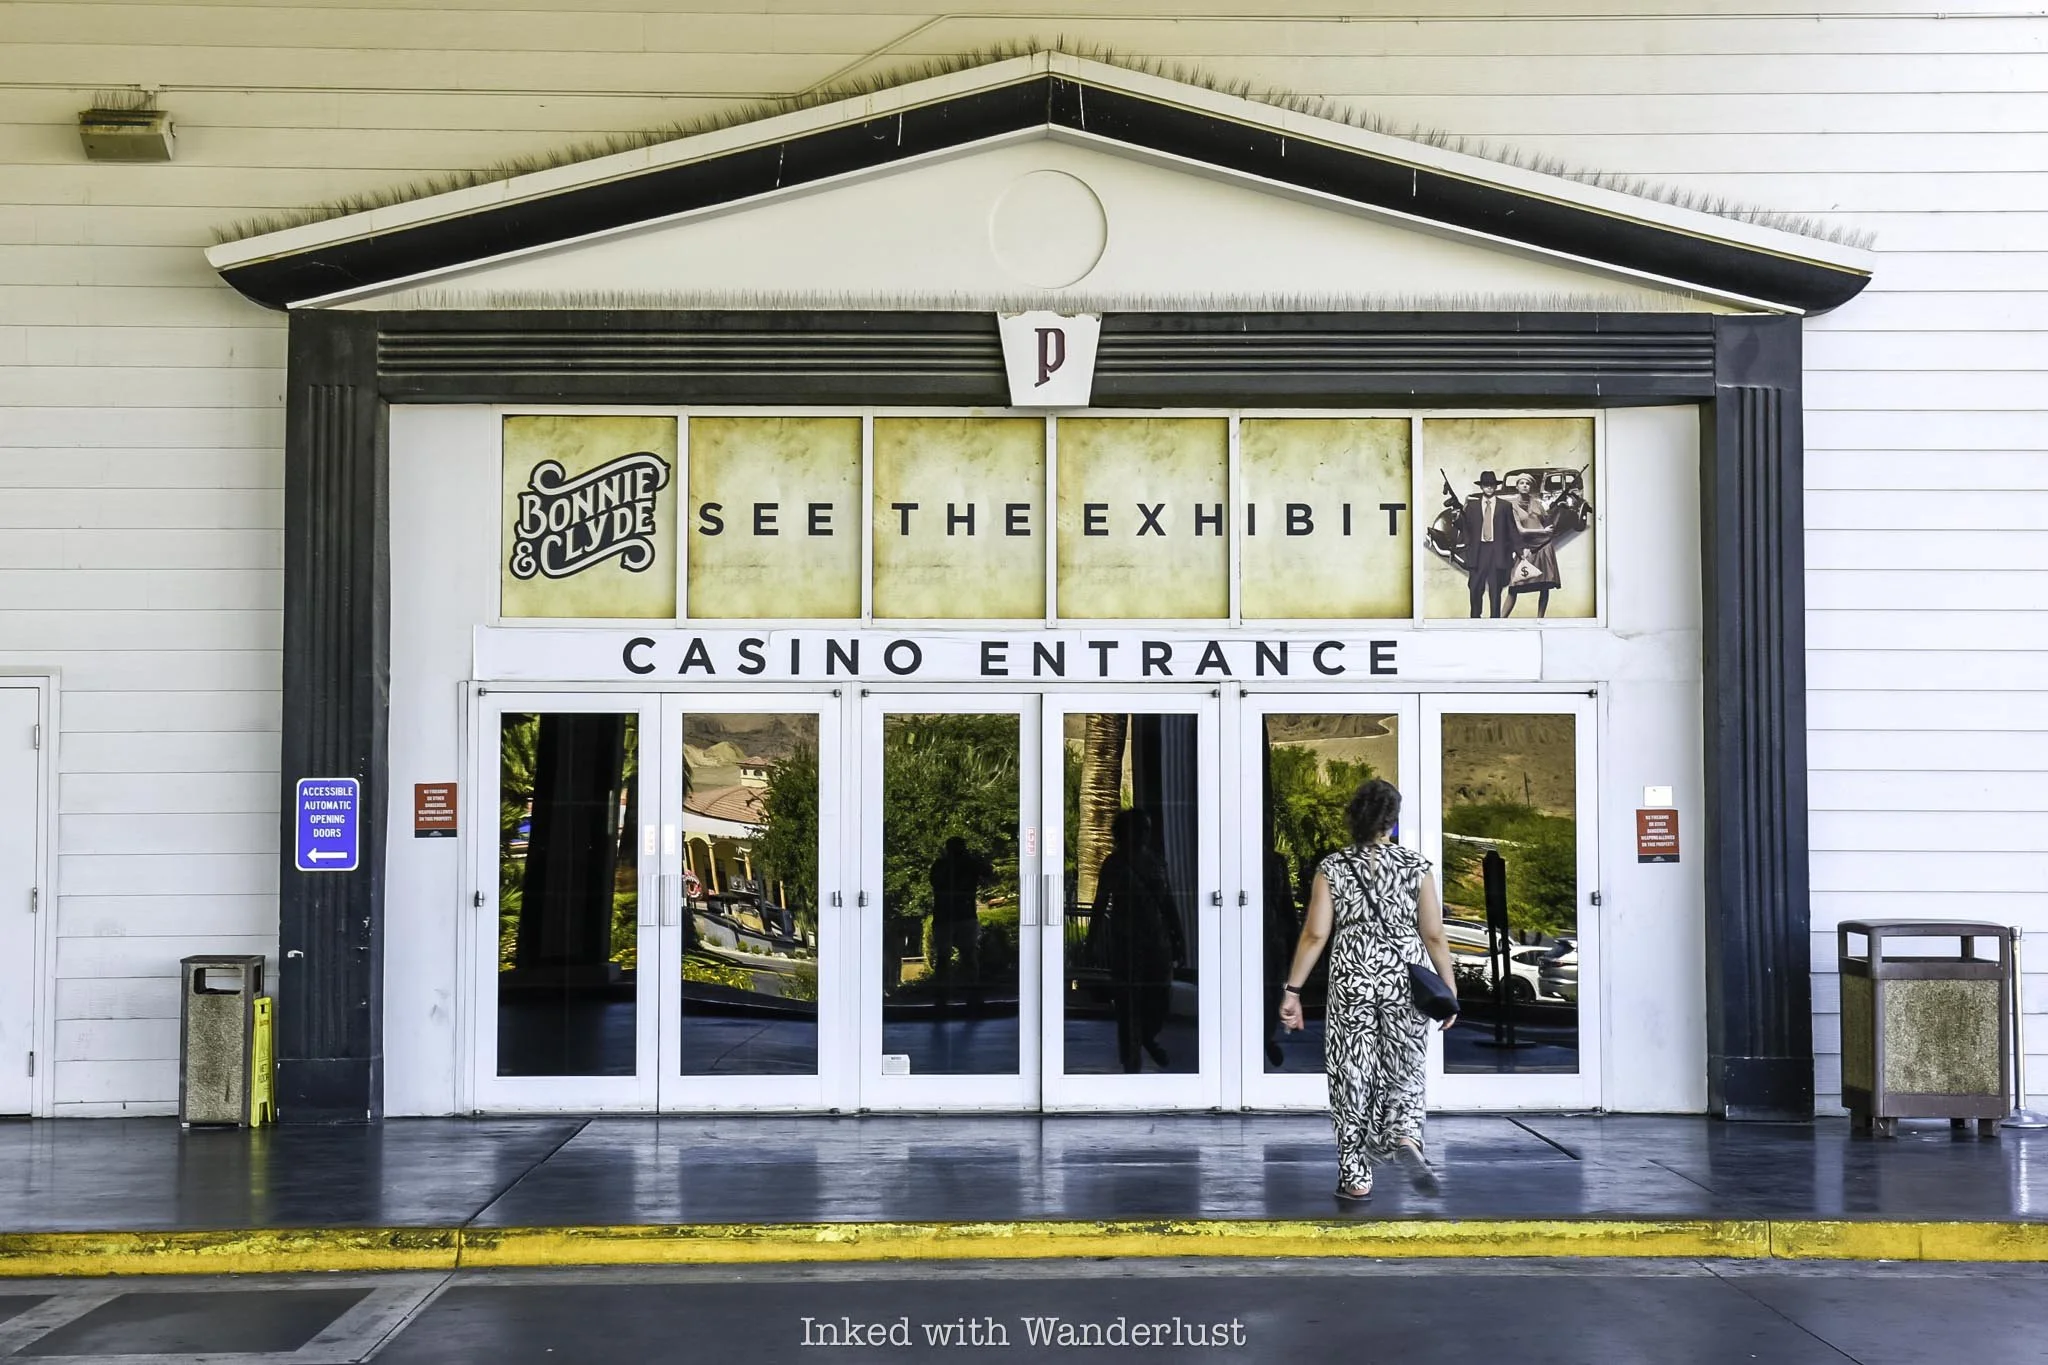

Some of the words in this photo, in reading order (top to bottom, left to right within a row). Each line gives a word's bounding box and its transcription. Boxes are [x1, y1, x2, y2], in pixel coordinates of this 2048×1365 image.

[517, 467, 654, 539] BONNIE
[698, 502, 834, 536] SEE
[891, 502, 1031, 536] THE
[1084, 503, 1407, 537] EXHIBIT
[512, 541, 537, 577] &
[540, 500, 654, 576] CLYDE
[622, 637, 923, 676] CASINO
[980, 640, 1398, 677] ENTRANCE
[303, 786, 353, 796] ACCESSIBLE
[304, 800, 352, 810] AUTOMATIC
[310, 814, 345, 824] OPENING
[313, 828, 342, 838] DOORS
